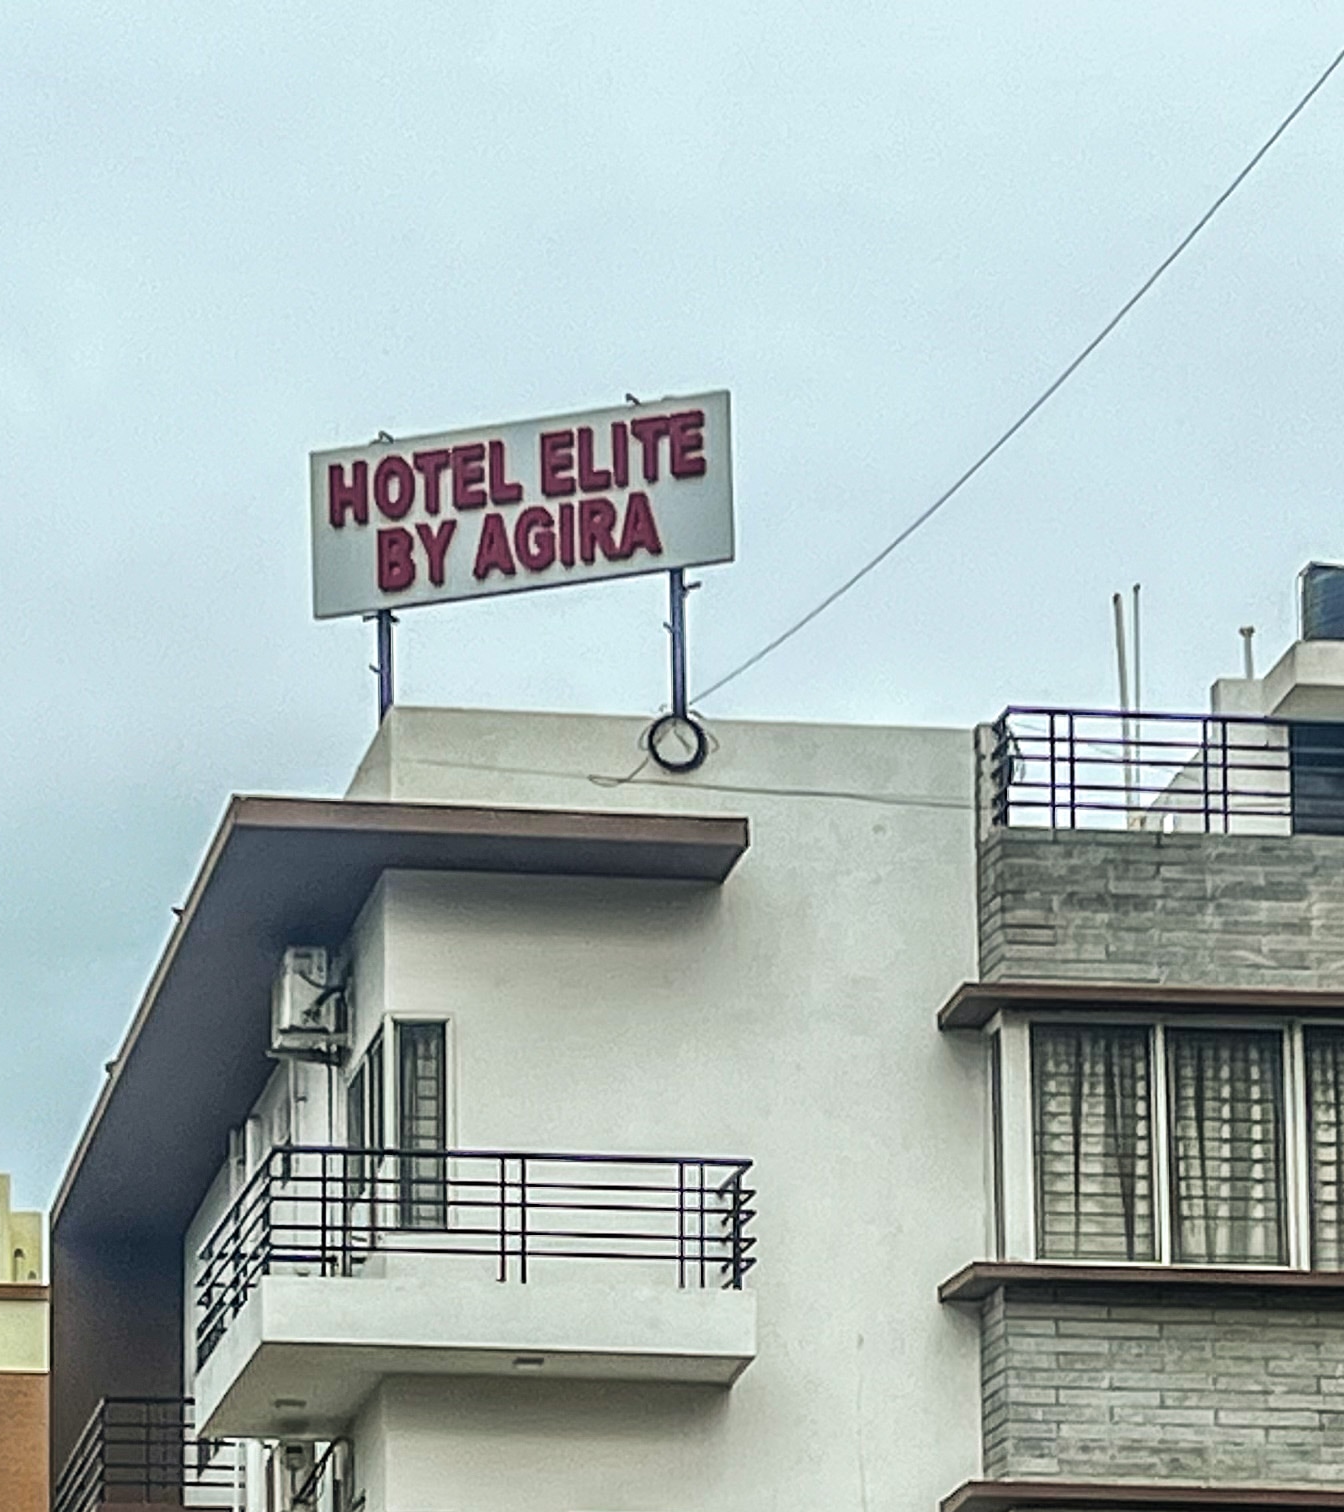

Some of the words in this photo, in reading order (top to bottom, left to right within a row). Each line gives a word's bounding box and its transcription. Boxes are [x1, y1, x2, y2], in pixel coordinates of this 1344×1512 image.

[327, 440, 524, 528] HOTEL
[539, 409, 707, 497] ELITE
[376, 518, 457, 593] BY
[472, 492, 663, 580] AGIRA
